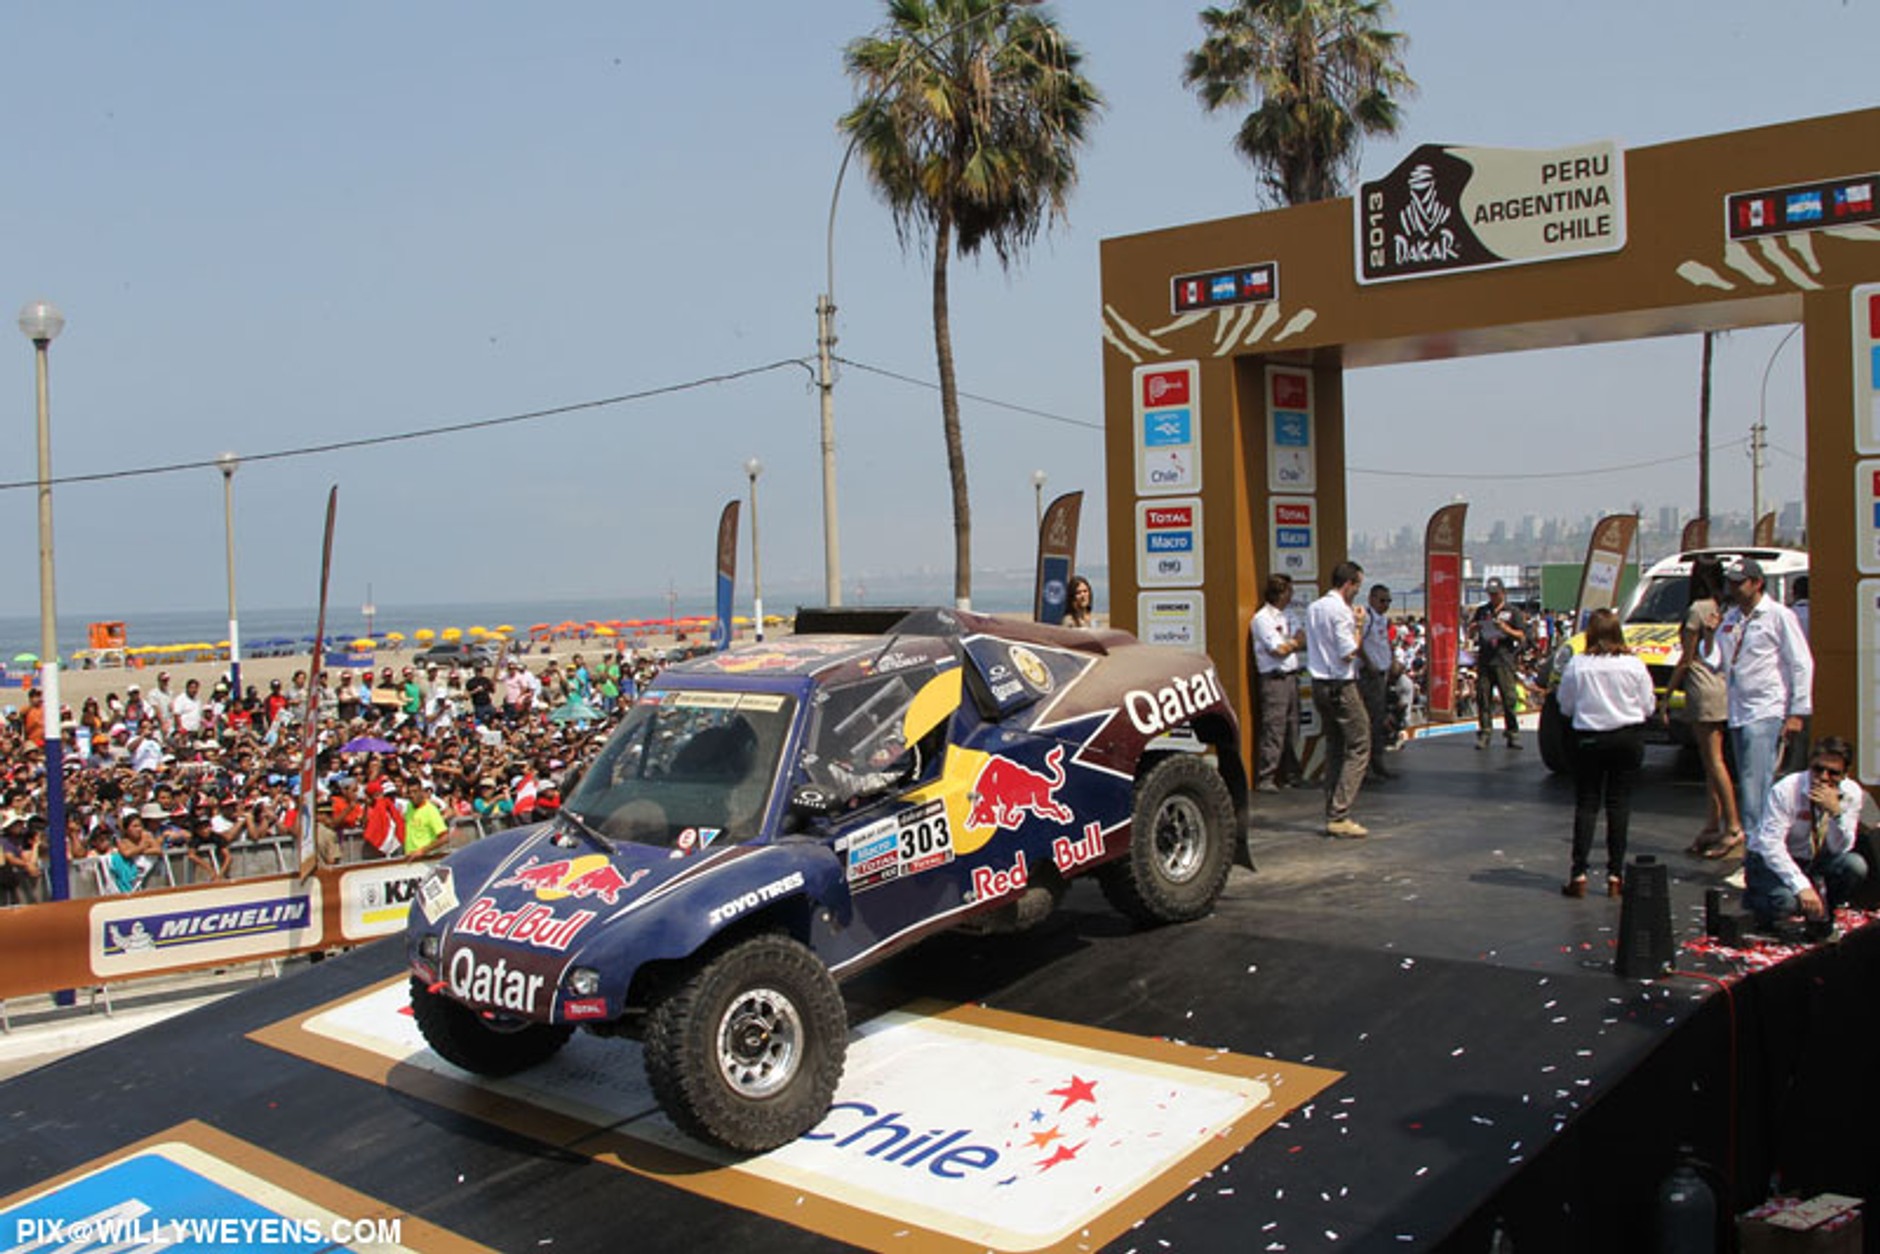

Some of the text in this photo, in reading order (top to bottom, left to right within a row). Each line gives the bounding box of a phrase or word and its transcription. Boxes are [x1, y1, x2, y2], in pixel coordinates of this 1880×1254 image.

[1541, 154, 1609, 185] PERU
[1473, 185, 1611, 226] ARGENTINA
[1369, 191, 1385, 267] 2013
[1394, 228, 1458, 265] DAKAR
[1542, 214, 1612, 244] CHILE
[1151, 470, 1178, 482] Chile
[1150, 536, 1188, 549] Macro
[1125, 668, 1221, 735] Qatar
[900, 817, 950, 860] 303
[1053, 823, 1105, 873] Bull
[708, 870, 806, 926] TOYO TIRES
[971, 851, 1029, 902] Red
[158, 902, 306, 939] MICHELIN
[453, 898, 596, 950] Red Bull
[449, 946, 544, 1014] Qatar
[801, 1101, 1000, 1178] Chile
